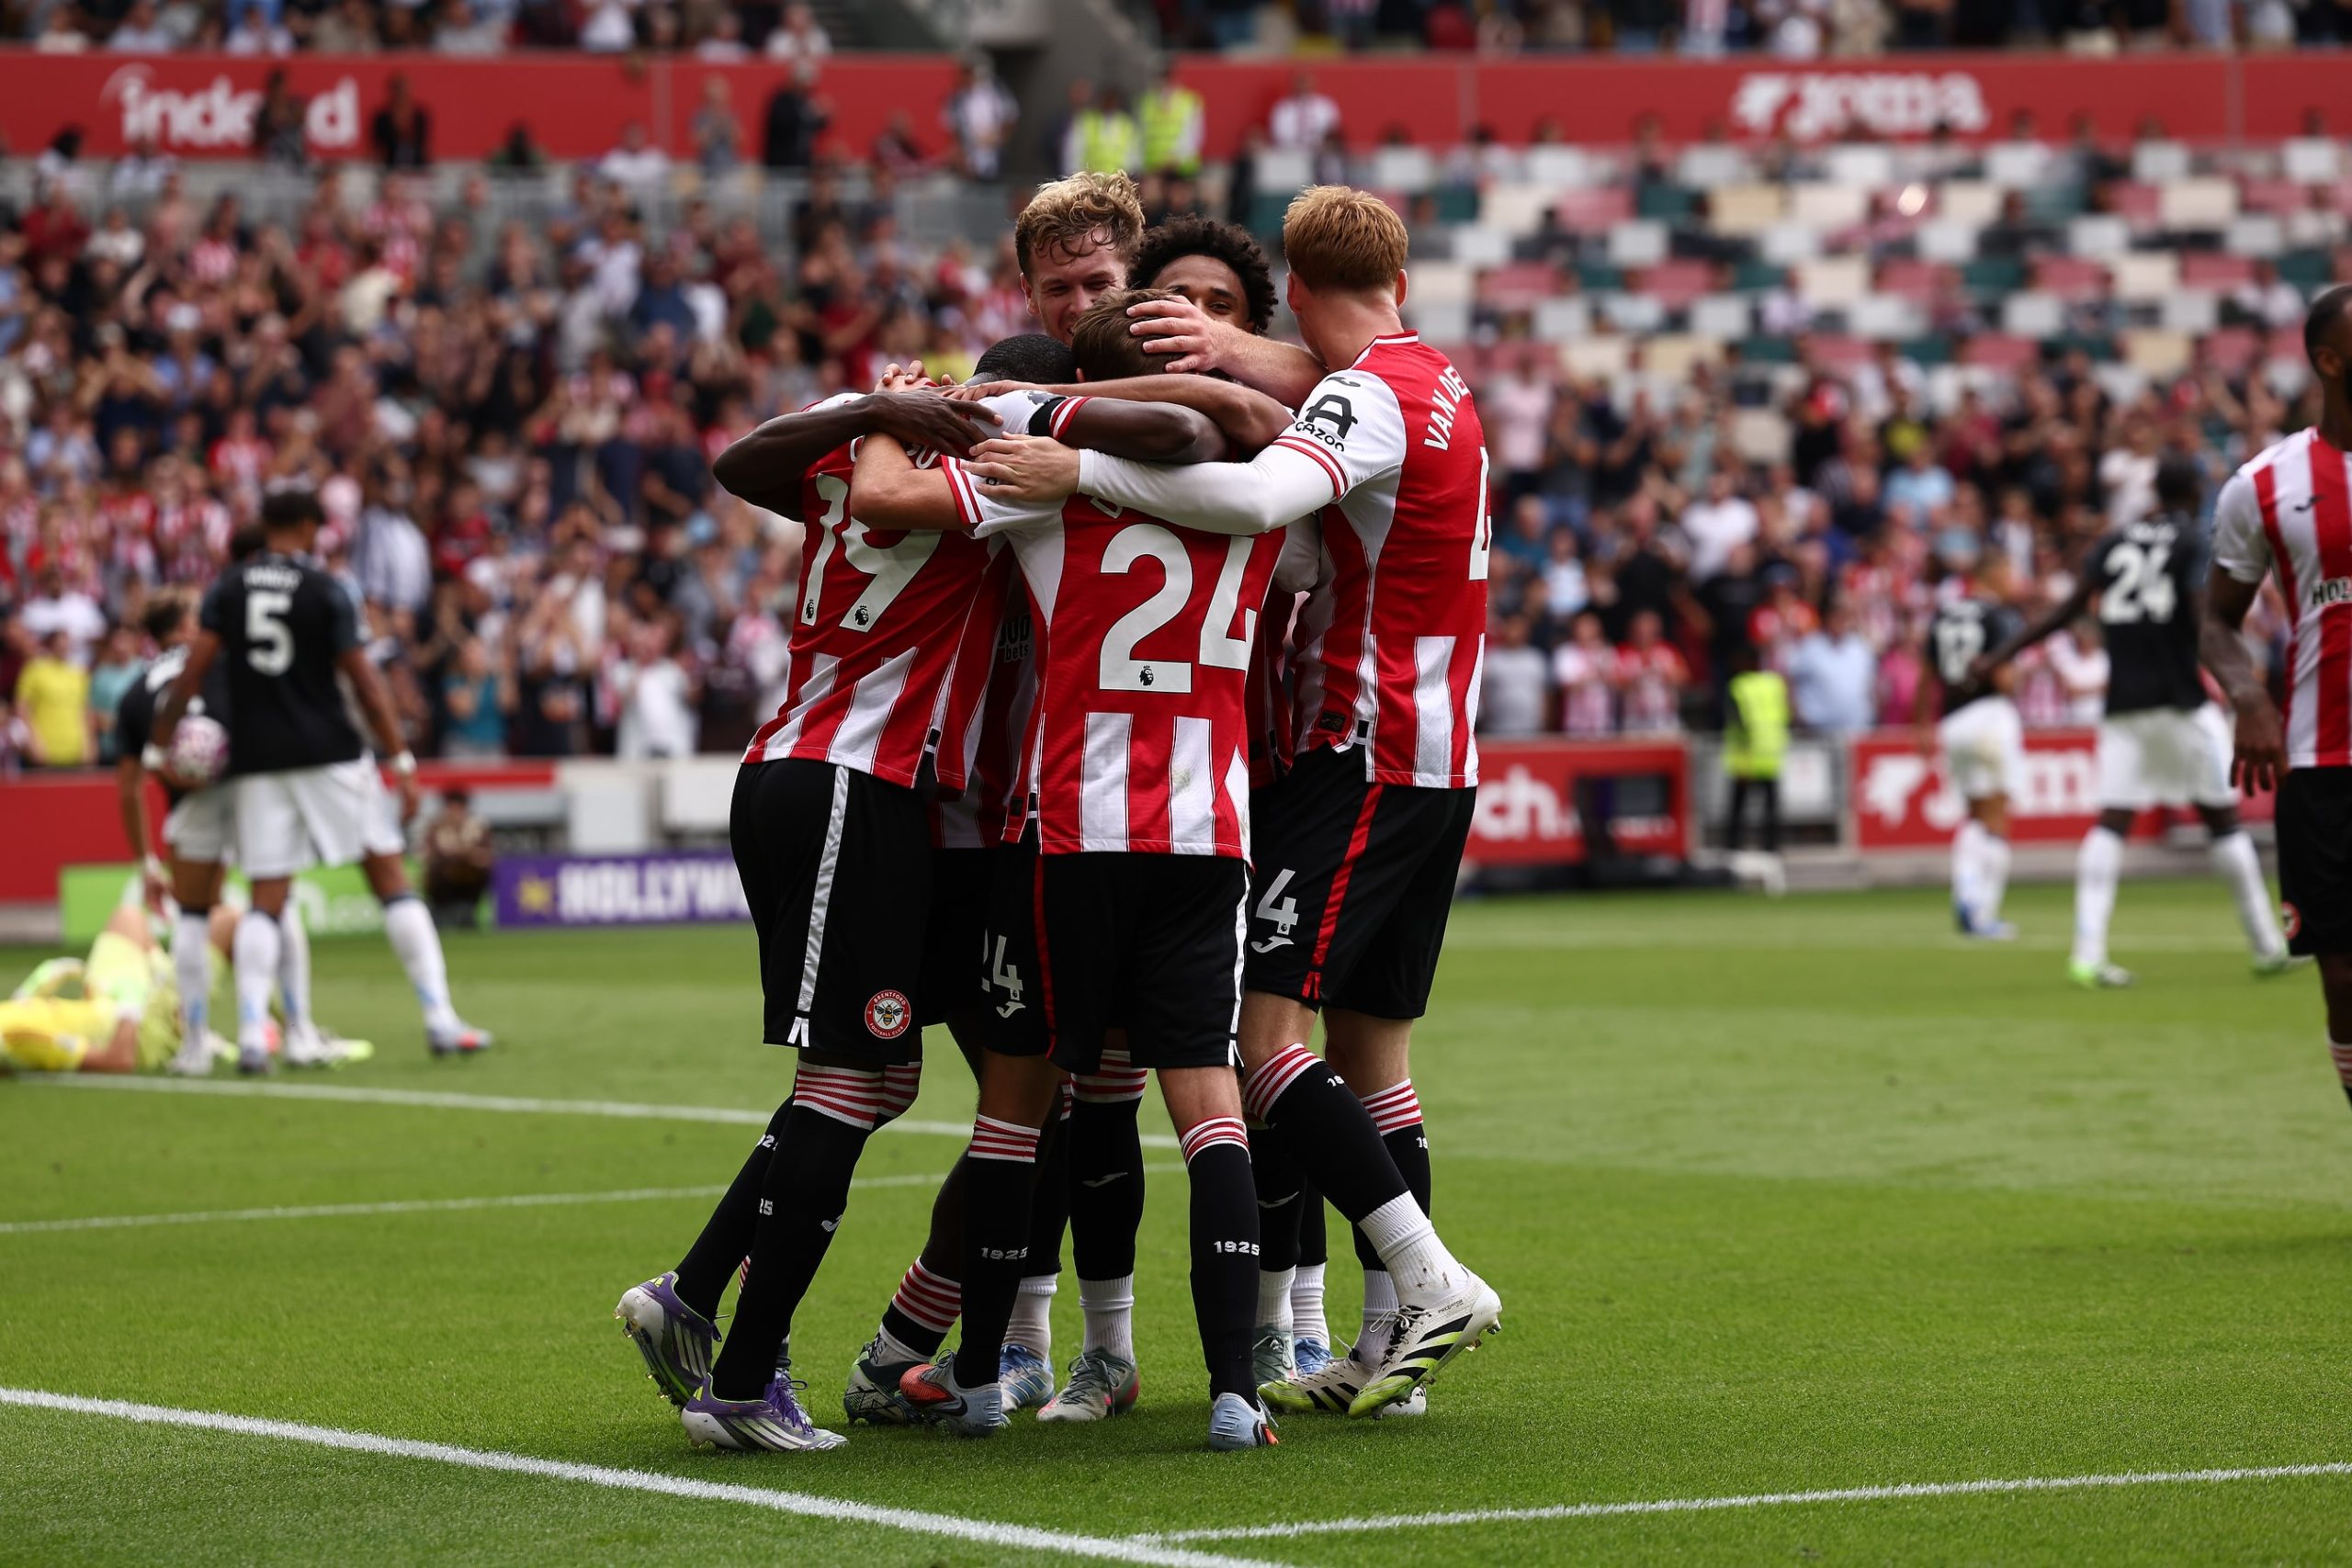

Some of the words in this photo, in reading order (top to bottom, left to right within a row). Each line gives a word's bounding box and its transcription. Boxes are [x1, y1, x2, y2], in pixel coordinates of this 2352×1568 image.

[121, 73, 359, 147] inded
[1424, 389, 1457, 451] VAN
[800, 472, 944, 633] 19
[245, 590, 295, 677] 5
[1099, 523, 1258, 694] 24
[1005, 644, 1029, 660] bets
[1255, 868, 1299, 935] 4
[869, 1022, 891, 1036] FOOTBALL
[873, 991, 906, 1006] BRENTFORD
